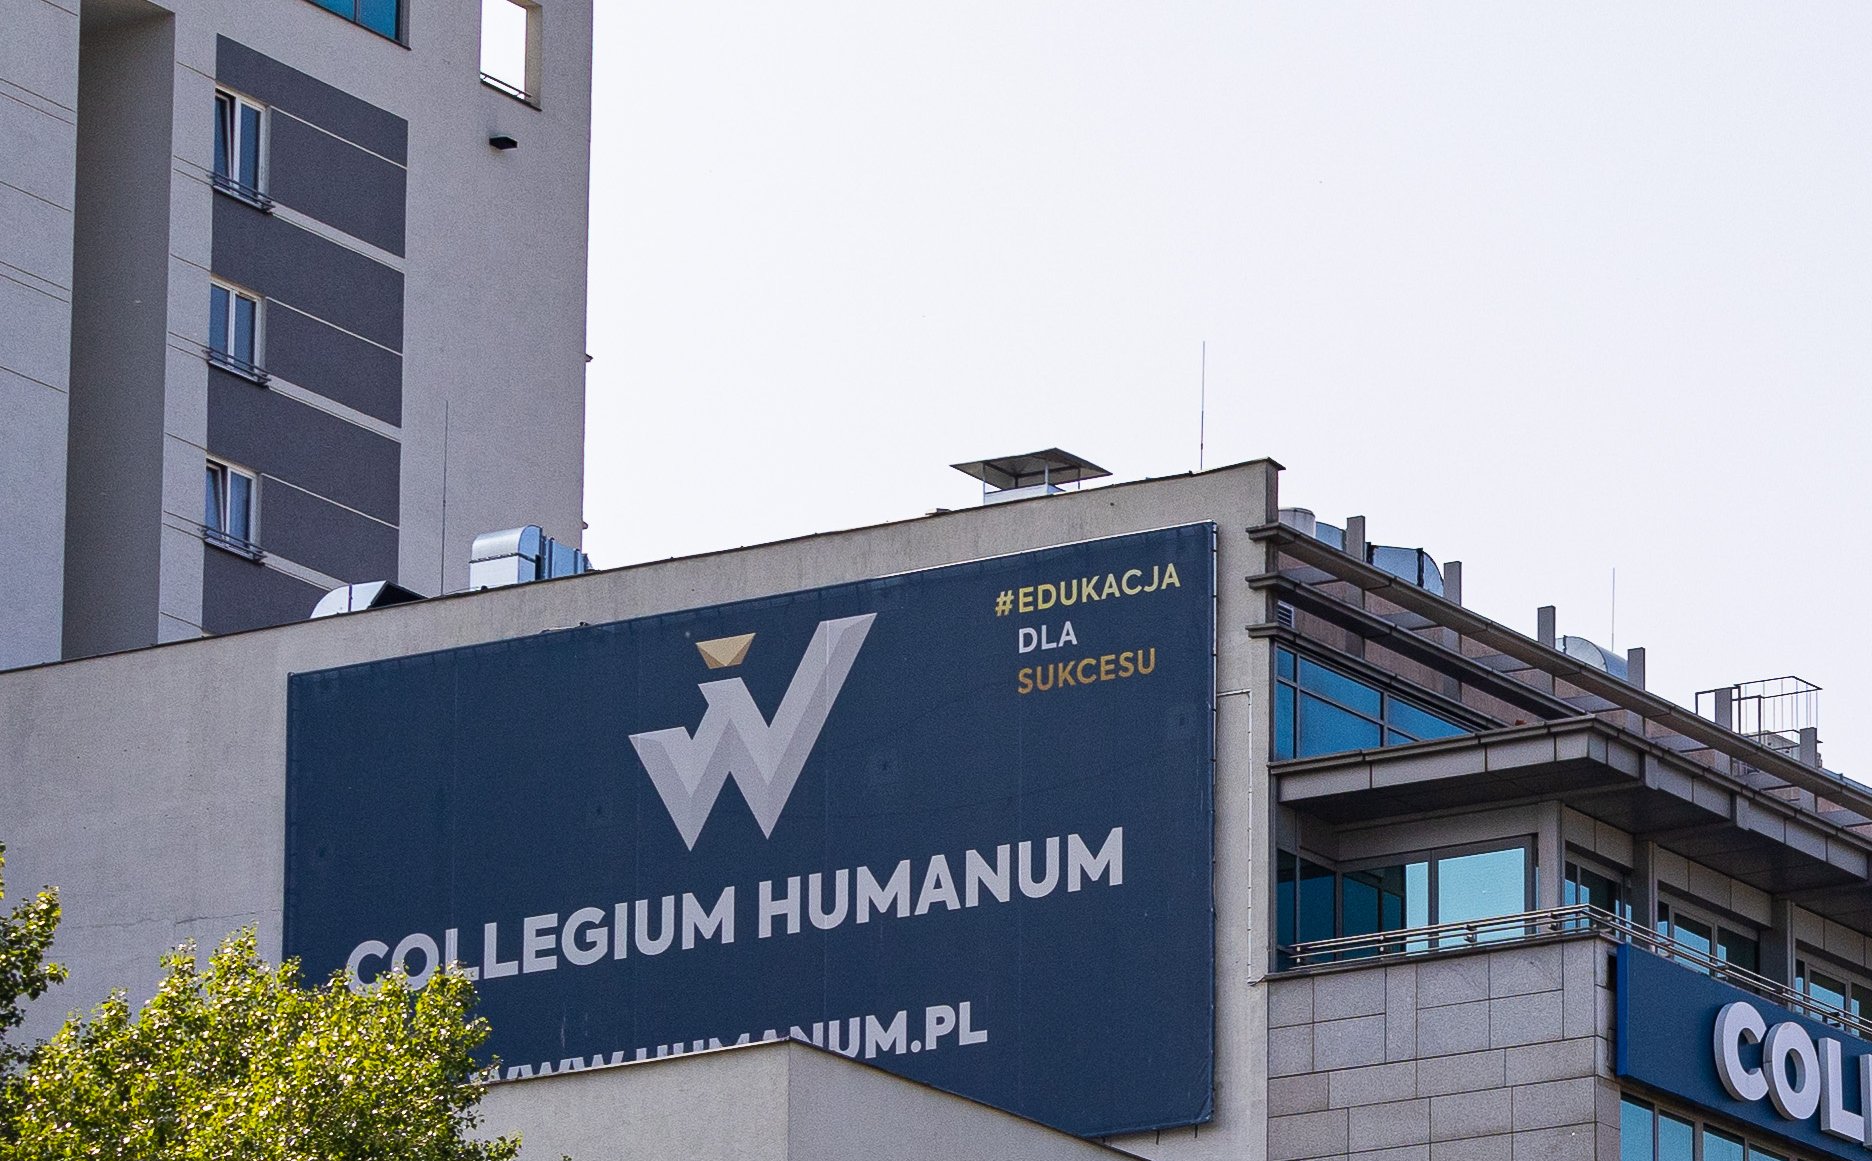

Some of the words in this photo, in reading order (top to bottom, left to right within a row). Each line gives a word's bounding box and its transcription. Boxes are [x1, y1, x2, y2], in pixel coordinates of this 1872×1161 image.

[995, 563, 1181, 616] #EDUKACJA
[1018, 621, 1078, 653] DLA
[1017, 647, 1156, 695] SUKCESU
[347, 886, 735, 996] COLLEGIUM
[759, 827, 1123, 938] HUMANUM
